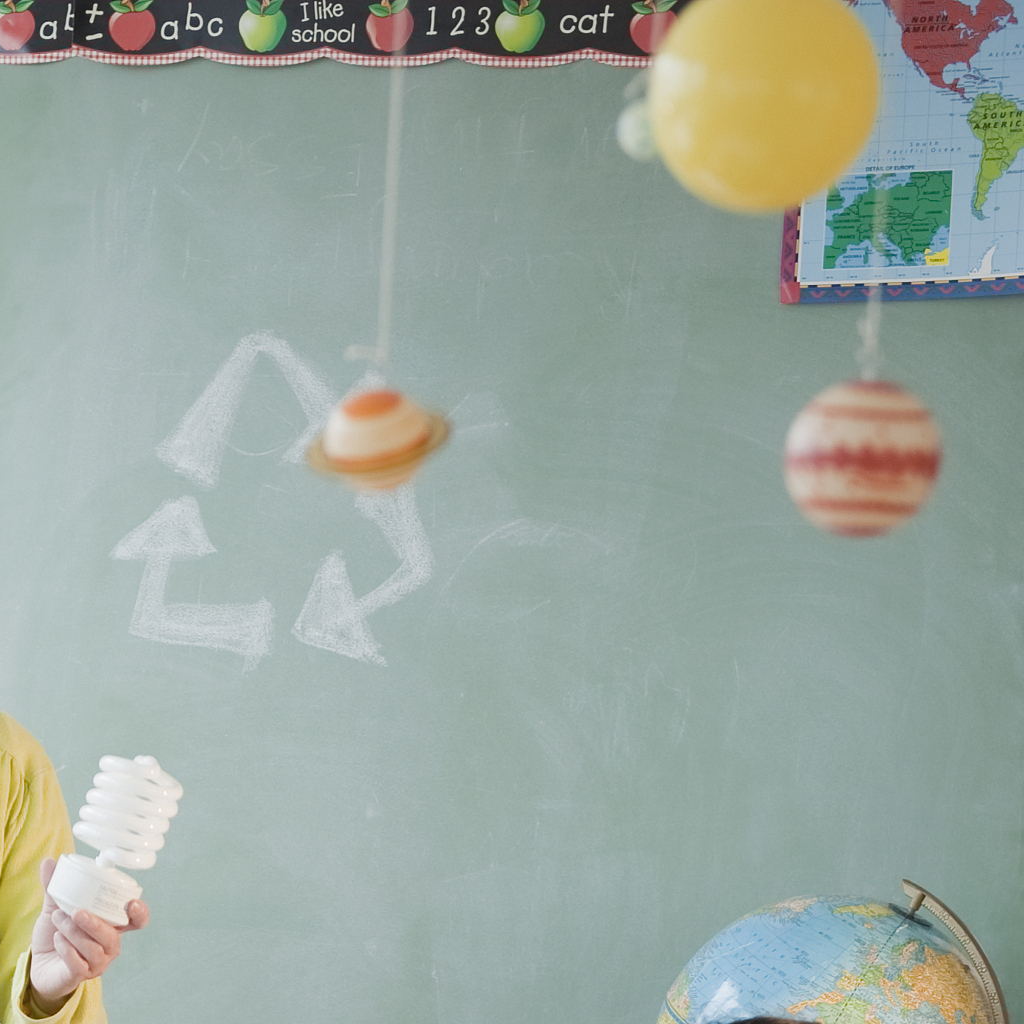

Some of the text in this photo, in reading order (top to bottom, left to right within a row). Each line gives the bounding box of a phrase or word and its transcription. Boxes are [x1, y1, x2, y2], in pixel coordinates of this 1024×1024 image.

[299, 0, 344, 22] I like
[559, 4, 615, 34] cat
[910, 14, 949, 23] NORTH
[291, 22, 356, 43] school
[903, 24, 955, 33] AMERICA
[982, 110, 1023, 120] SOUTH
[973, 120, 1024, 130] AMERIC
